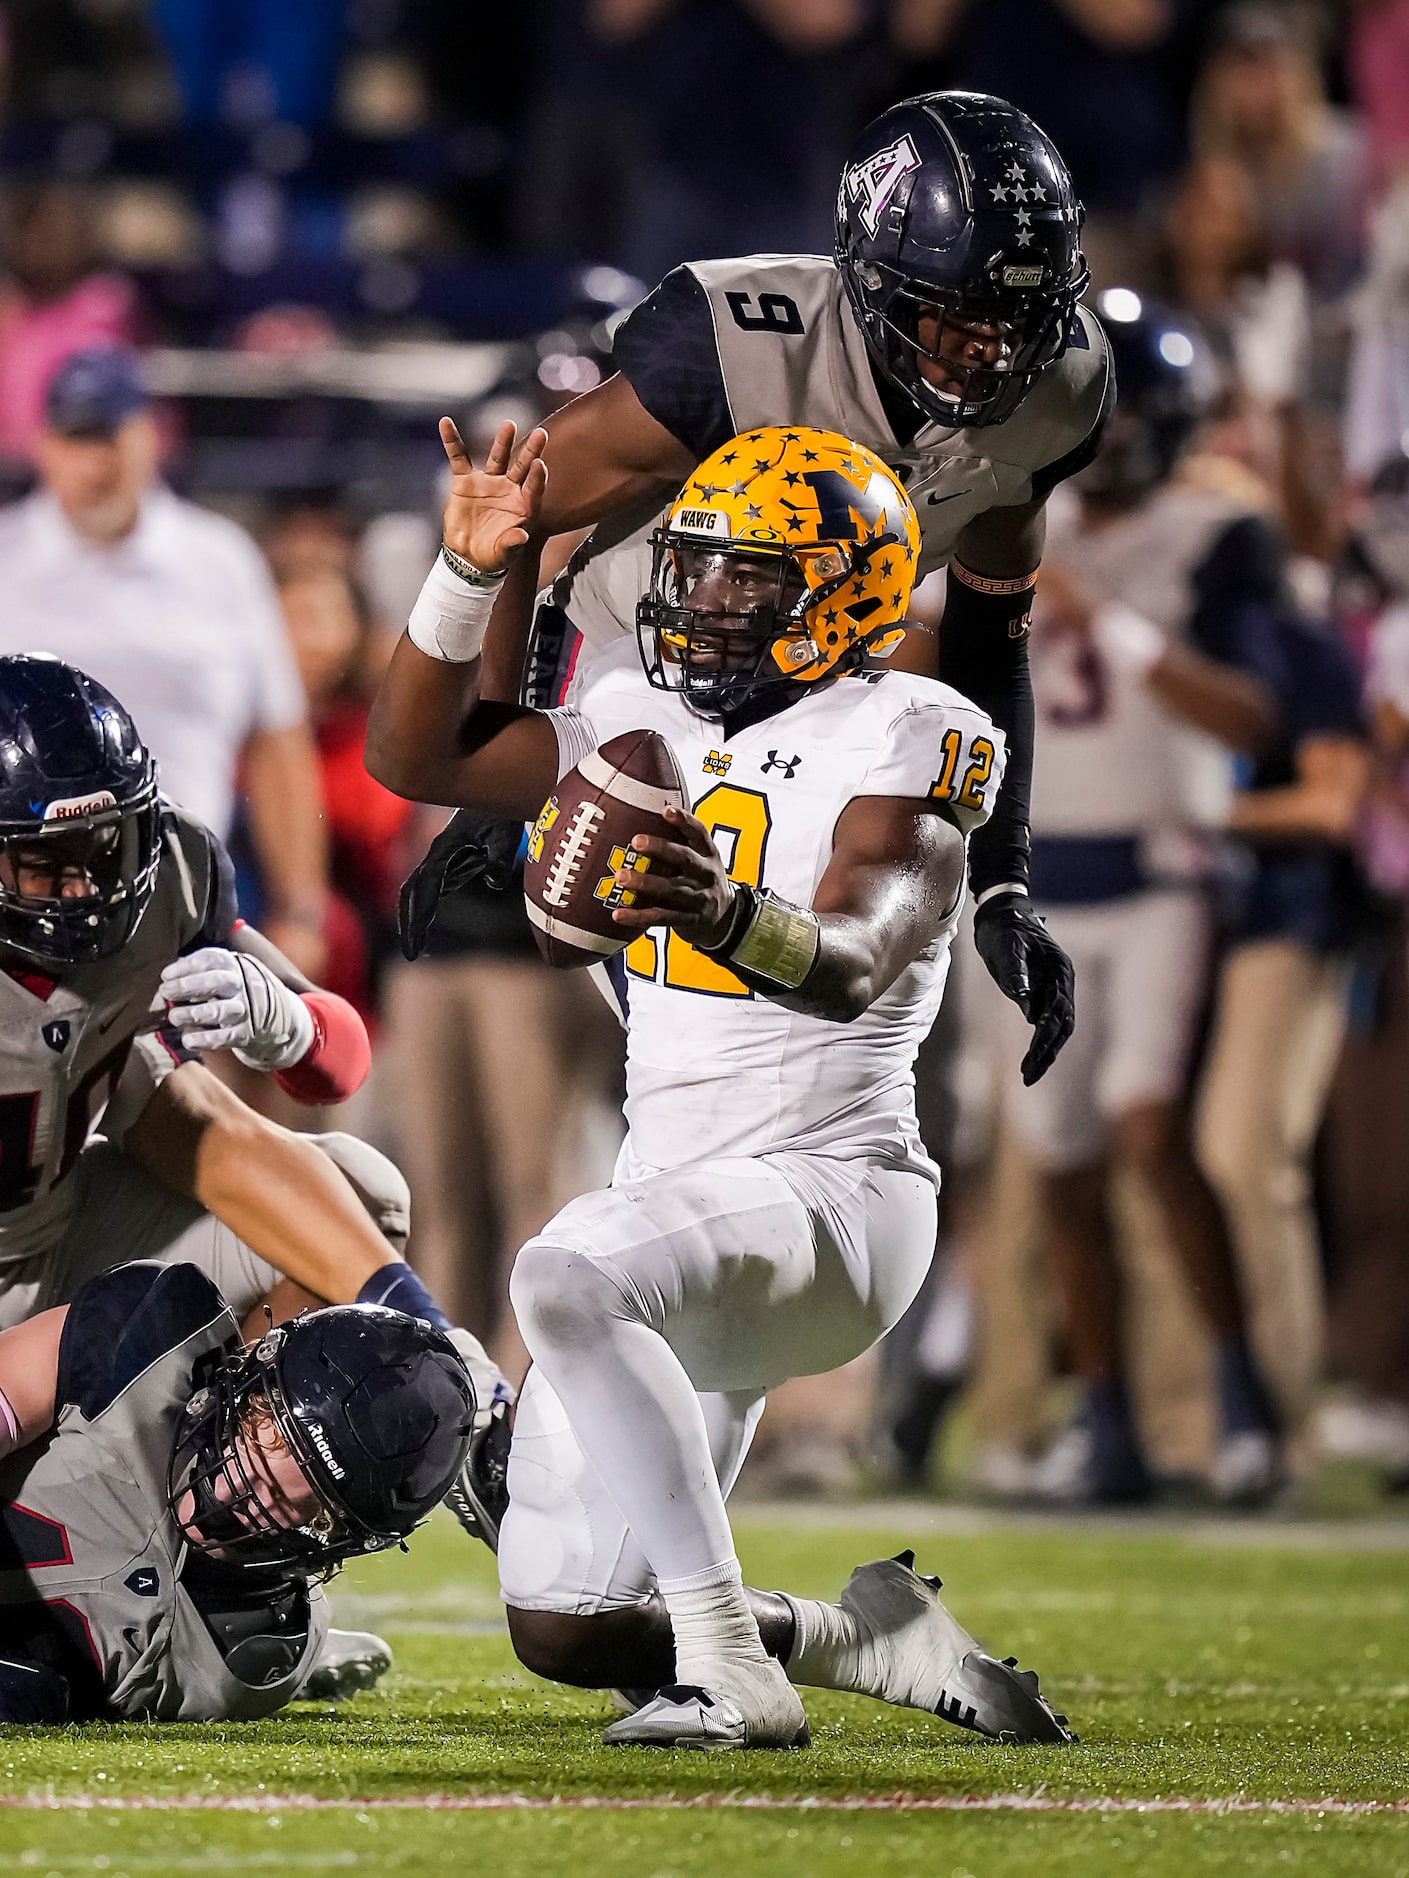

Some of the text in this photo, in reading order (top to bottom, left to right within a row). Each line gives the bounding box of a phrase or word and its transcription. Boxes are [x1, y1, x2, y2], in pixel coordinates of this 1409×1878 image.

[846, 132, 923, 242] A
[724, 291, 806, 335] 9
[680, 510, 717, 530] WAWG
[703, 757, 731, 770] LIONS
[926, 728, 995, 811] 12
[56, 797, 110, 818] Riddell
[308, 1422, 345, 1480] Riddell
[139, 1577, 153, 1588] A
